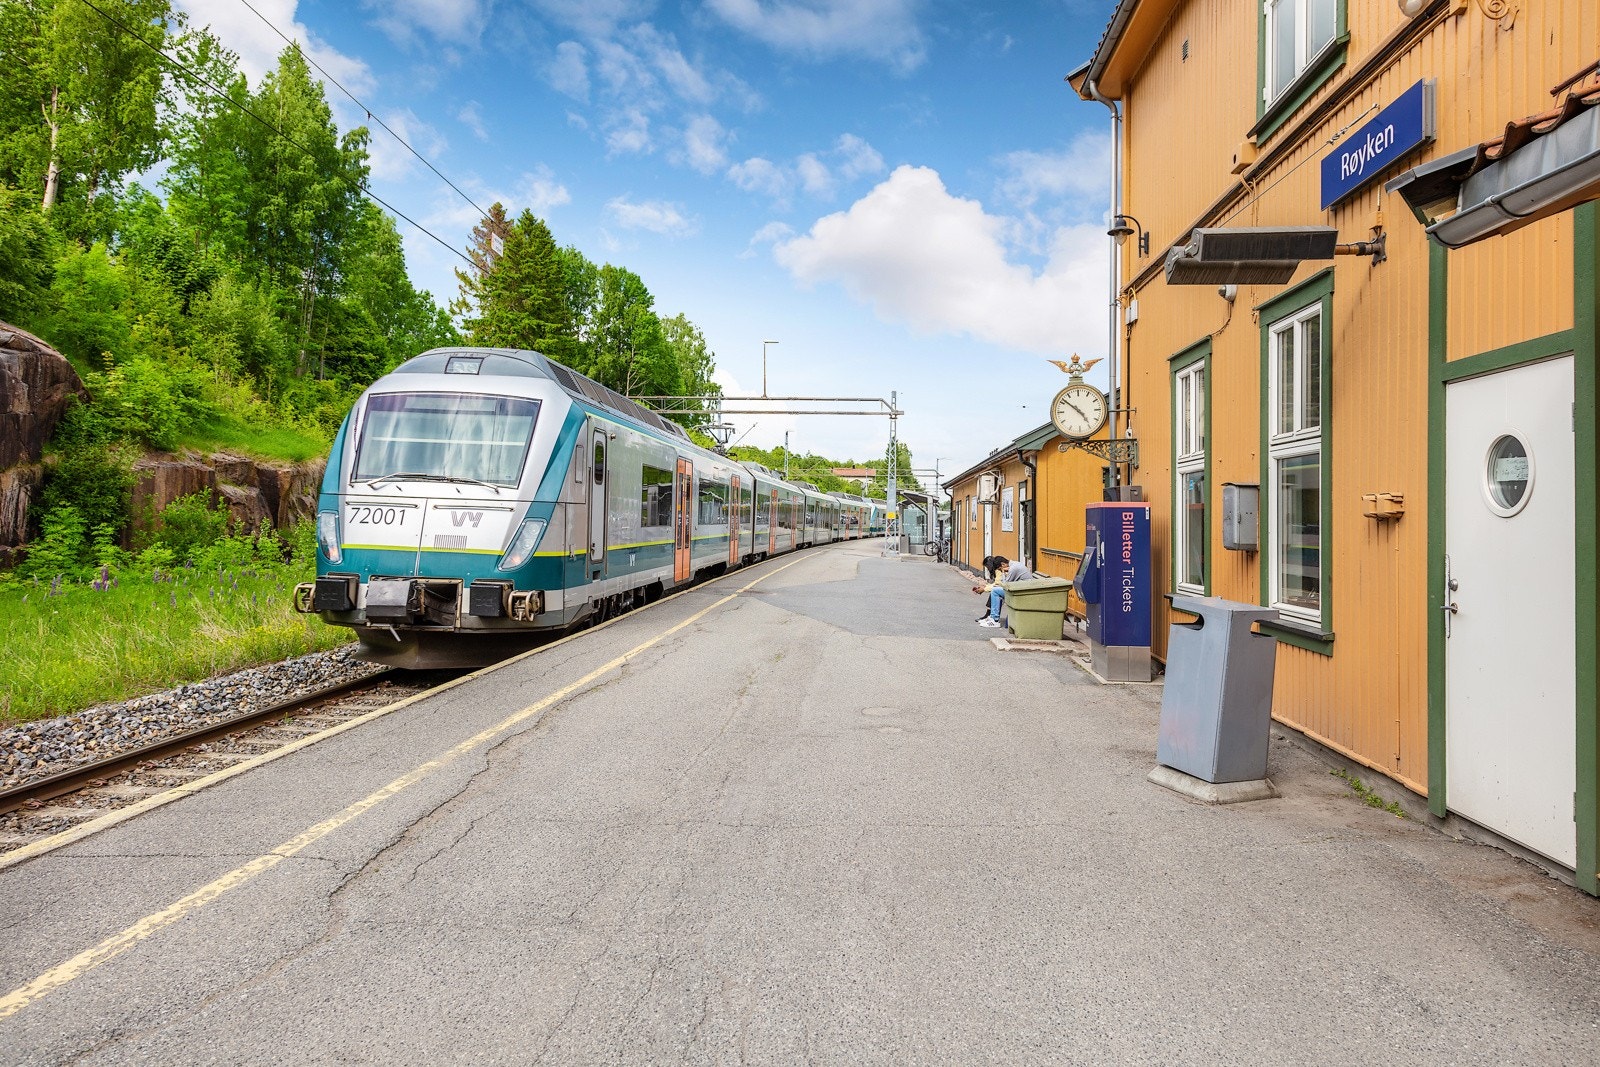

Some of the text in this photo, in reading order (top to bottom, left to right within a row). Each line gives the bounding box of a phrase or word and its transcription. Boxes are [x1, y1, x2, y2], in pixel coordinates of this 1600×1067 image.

[1341, 123, 1394, 181] Røyken
[348, 507, 406, 526] 72001
[1122, 511, 1135, 613] Billetter Tickets
